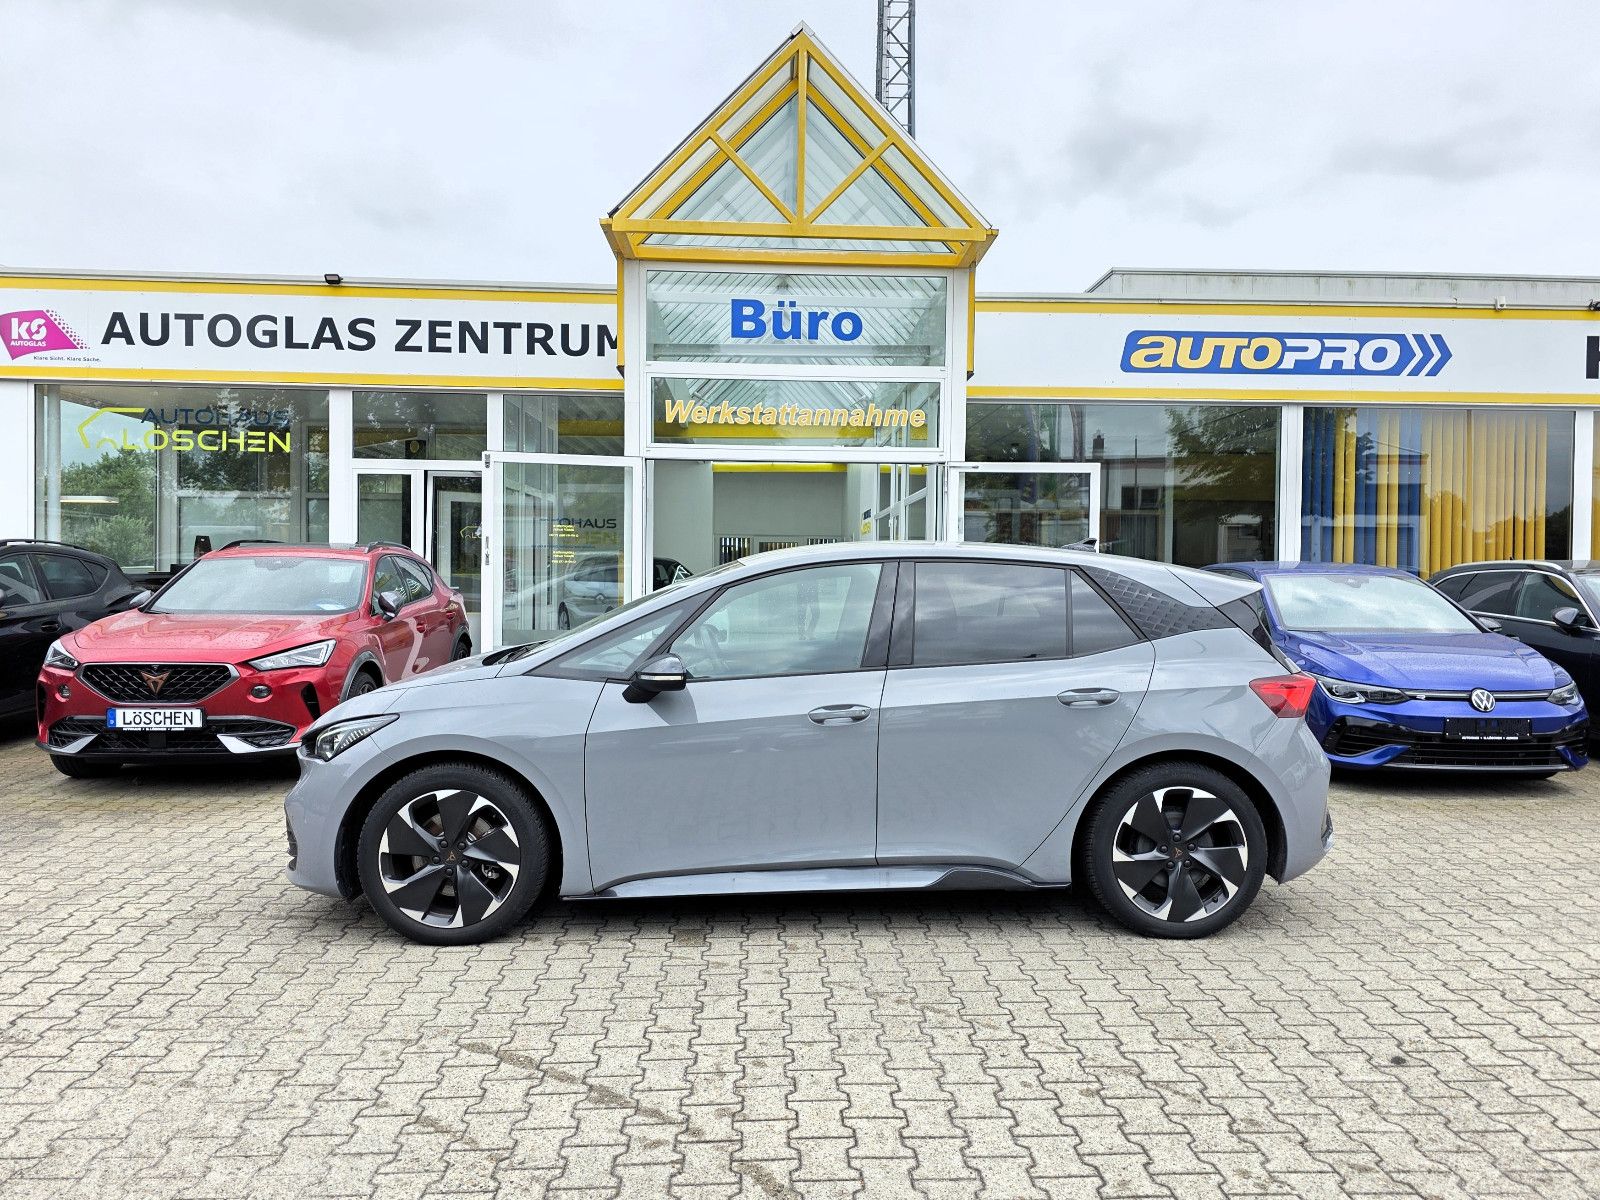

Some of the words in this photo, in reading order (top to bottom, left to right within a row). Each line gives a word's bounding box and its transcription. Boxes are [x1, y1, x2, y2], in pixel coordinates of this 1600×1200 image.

[100, 311, 377, 352] AUTOGLAS
[394, 318, 618, 357] ZENTRUM
[730, 298, 863, 342] Büro
[140, 408, 291, 426] AUTOHAUS
[664, 399, 927, 428] Werkstattannahme
